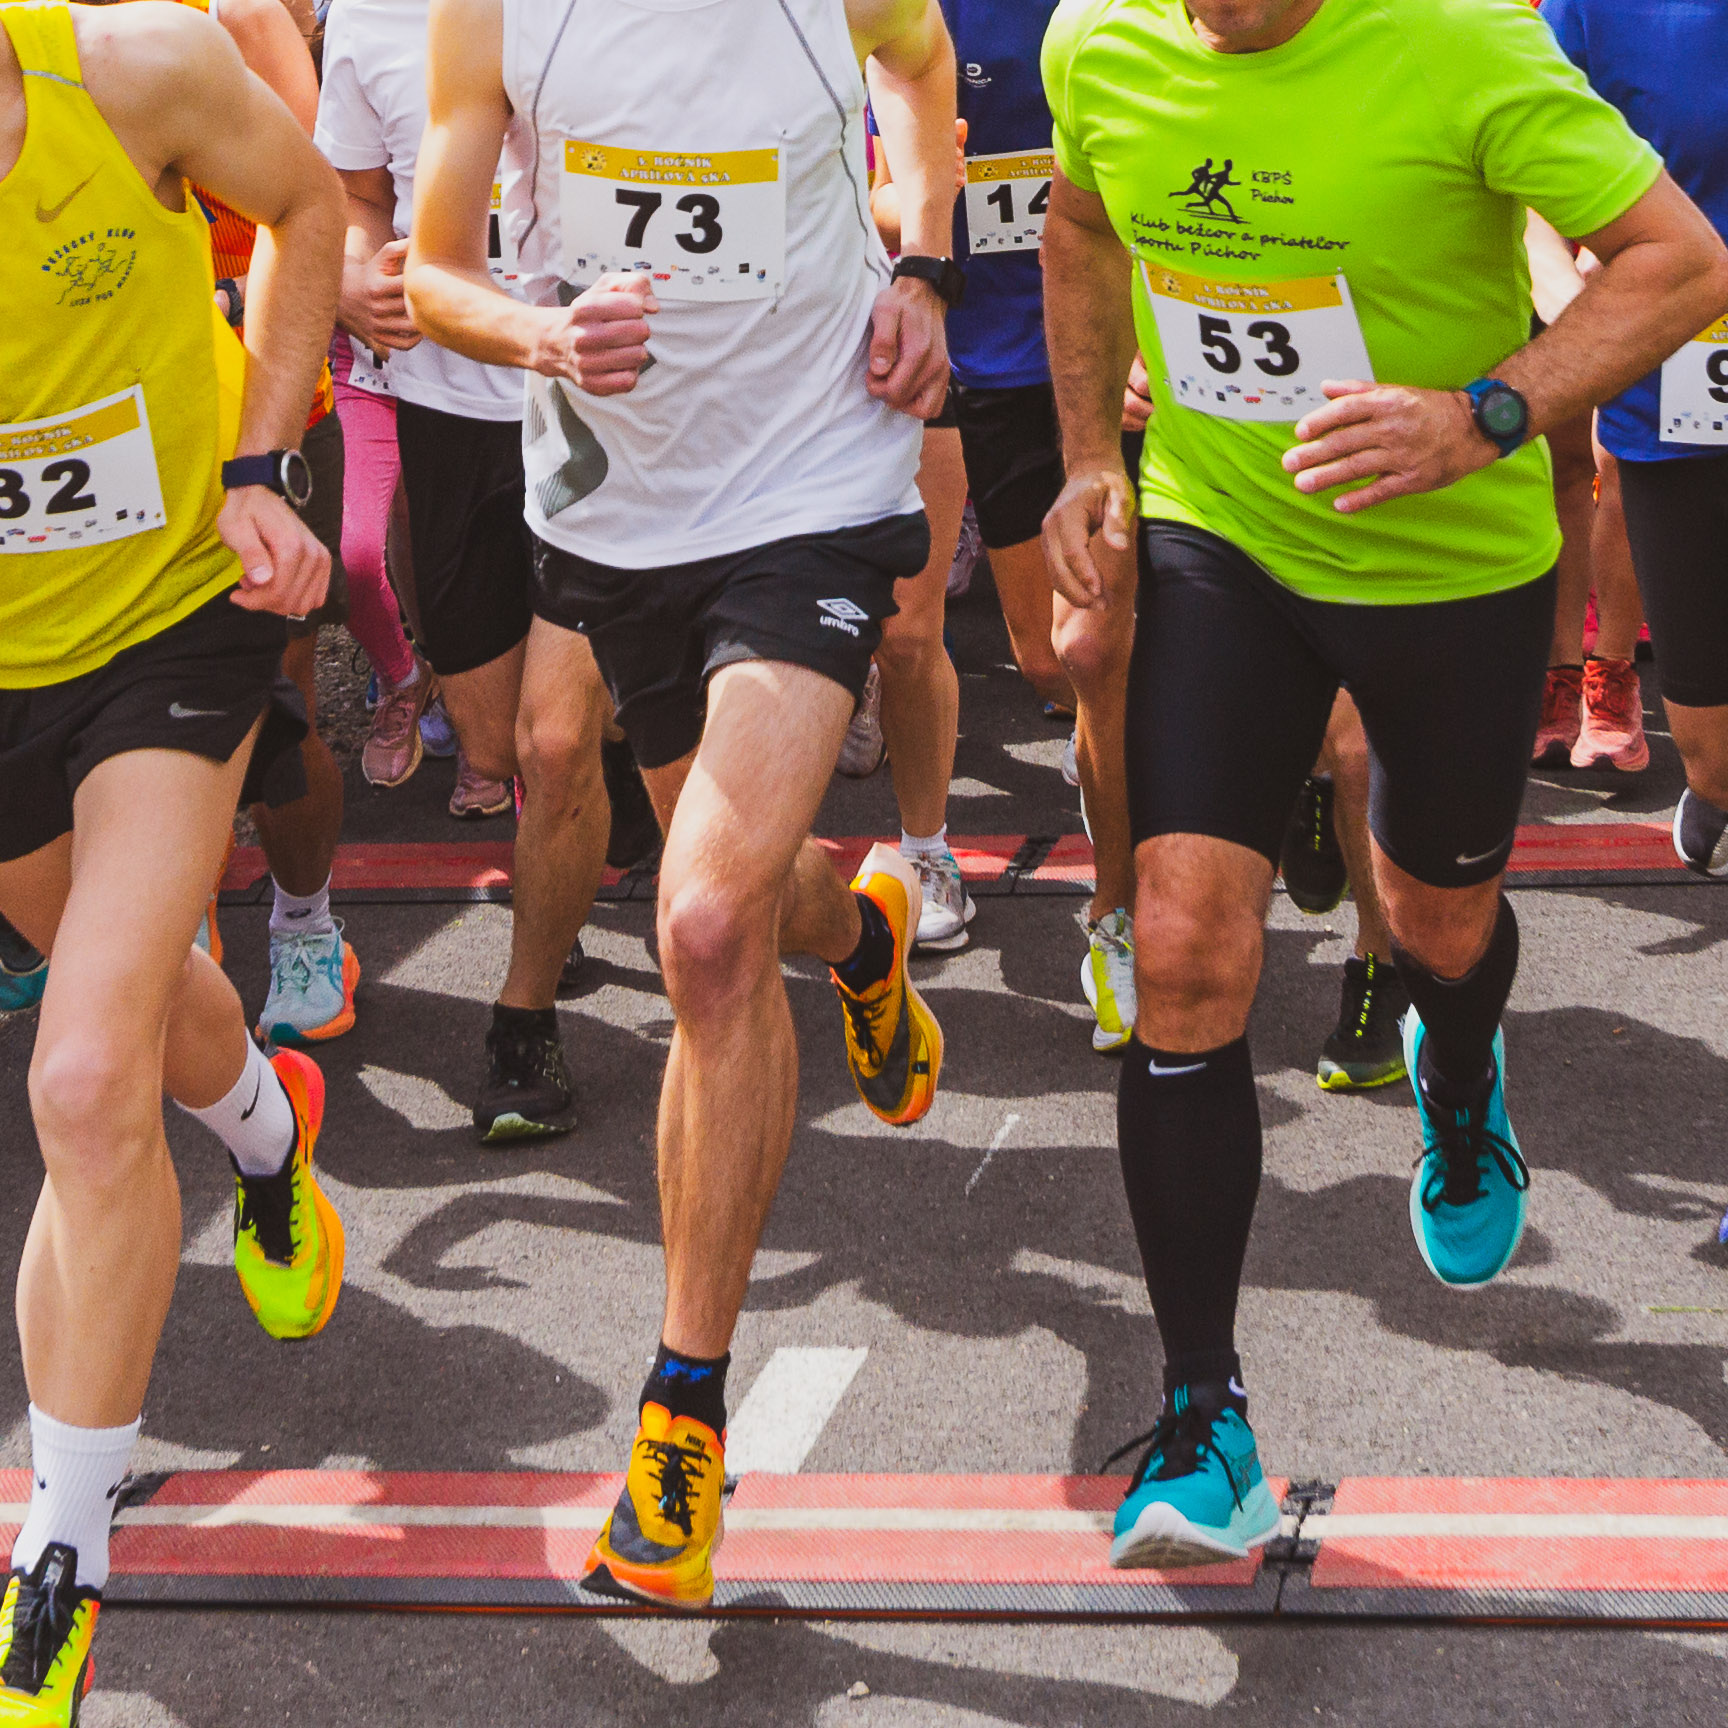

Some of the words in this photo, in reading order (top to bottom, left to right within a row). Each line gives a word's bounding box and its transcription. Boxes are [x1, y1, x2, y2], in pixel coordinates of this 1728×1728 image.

[1251, 170, 1292, 186] KBPŠ
[615, 188, 723, 254] 73
[1131, 211, 1171, 232] Klub
[1176, 220, 1236, 240] bežcov
[1241, 232, 1254, 242] a
[1260, 233, 1351, 250] priateľov
[1190, 241, 1262, 261] Púchov
[1198, 314, 1300, 376] 53
[820, 614, 860, 638] umbro
